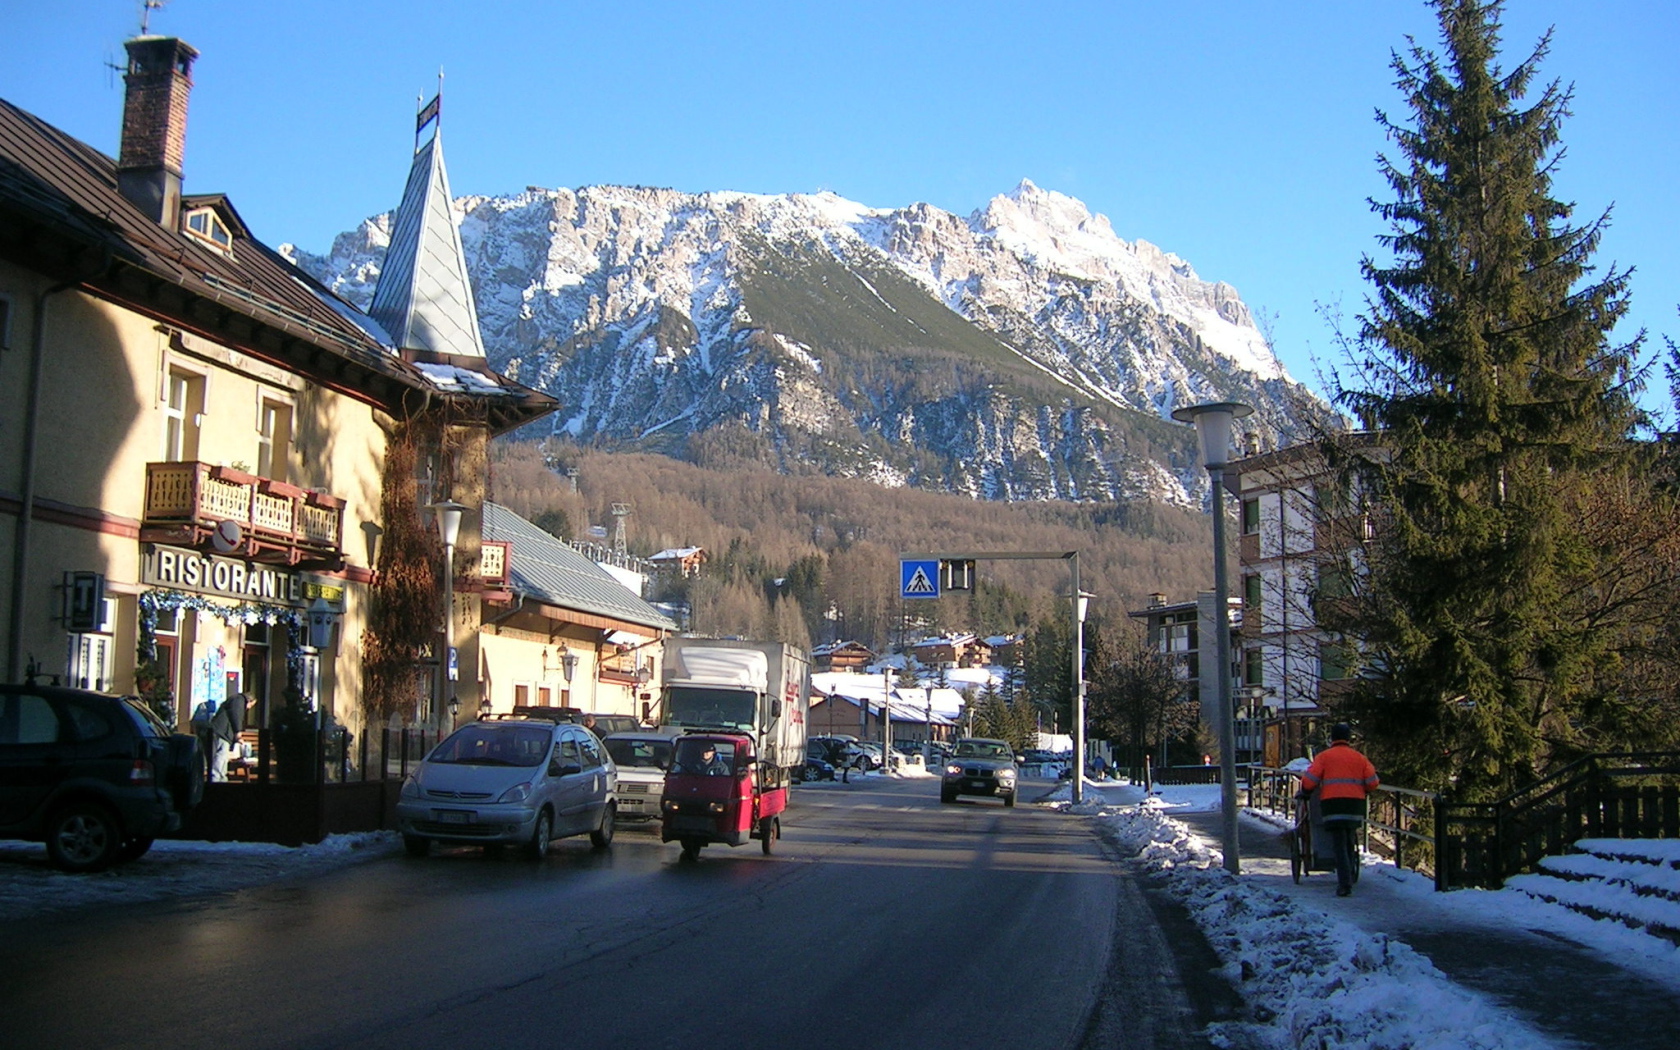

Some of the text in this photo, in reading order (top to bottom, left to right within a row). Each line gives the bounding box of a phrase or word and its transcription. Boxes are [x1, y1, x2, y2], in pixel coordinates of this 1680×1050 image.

[160, 551, 300, 601] RISTORANTE
[76, 579, 94, 611] T
[449, 648, 457, 666] P
